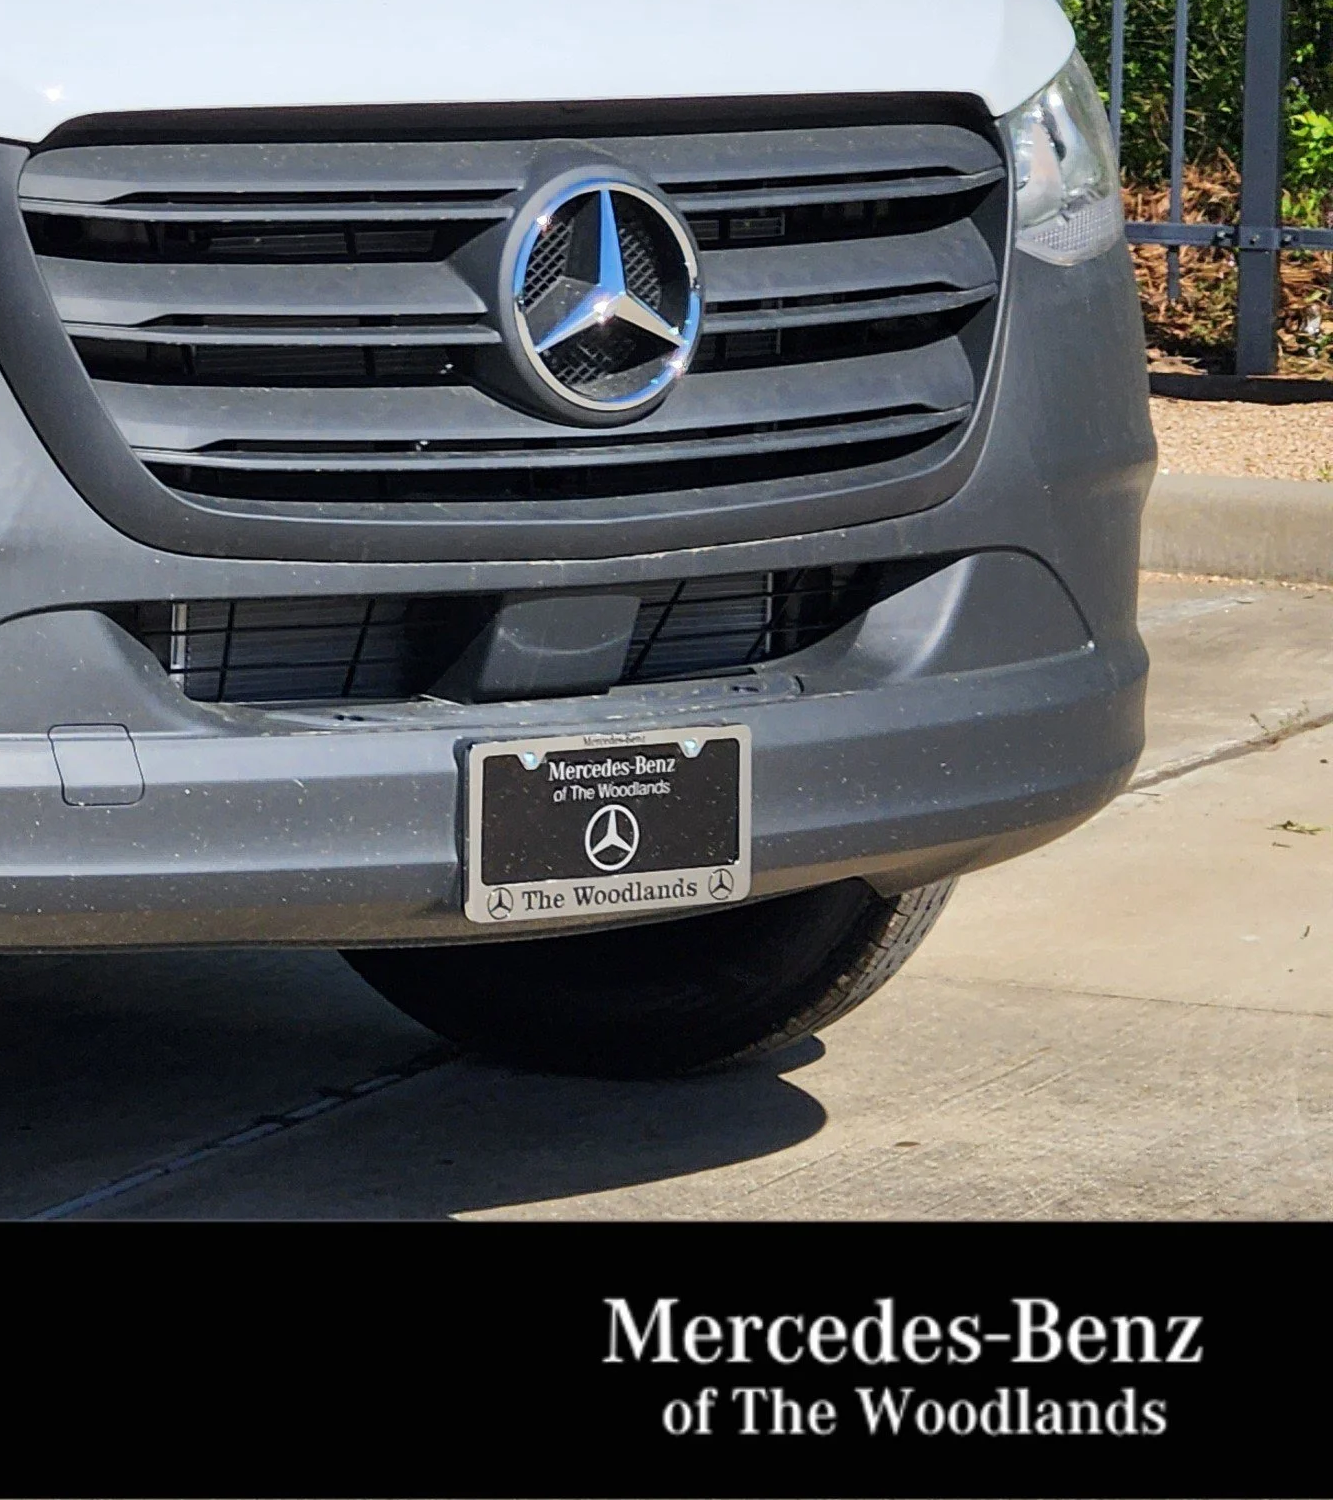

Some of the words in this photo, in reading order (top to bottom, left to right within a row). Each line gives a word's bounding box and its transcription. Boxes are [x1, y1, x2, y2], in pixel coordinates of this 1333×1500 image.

[547, 754, 676, 782] Mercedes-Benz
[553, 785, 568, 803] of
[570, 784, 596, 801] The
[597, 779, 671, 800] Woodlands
[521, 889, 566, 911] The
[573, 877, 699, 907] Woodlands
